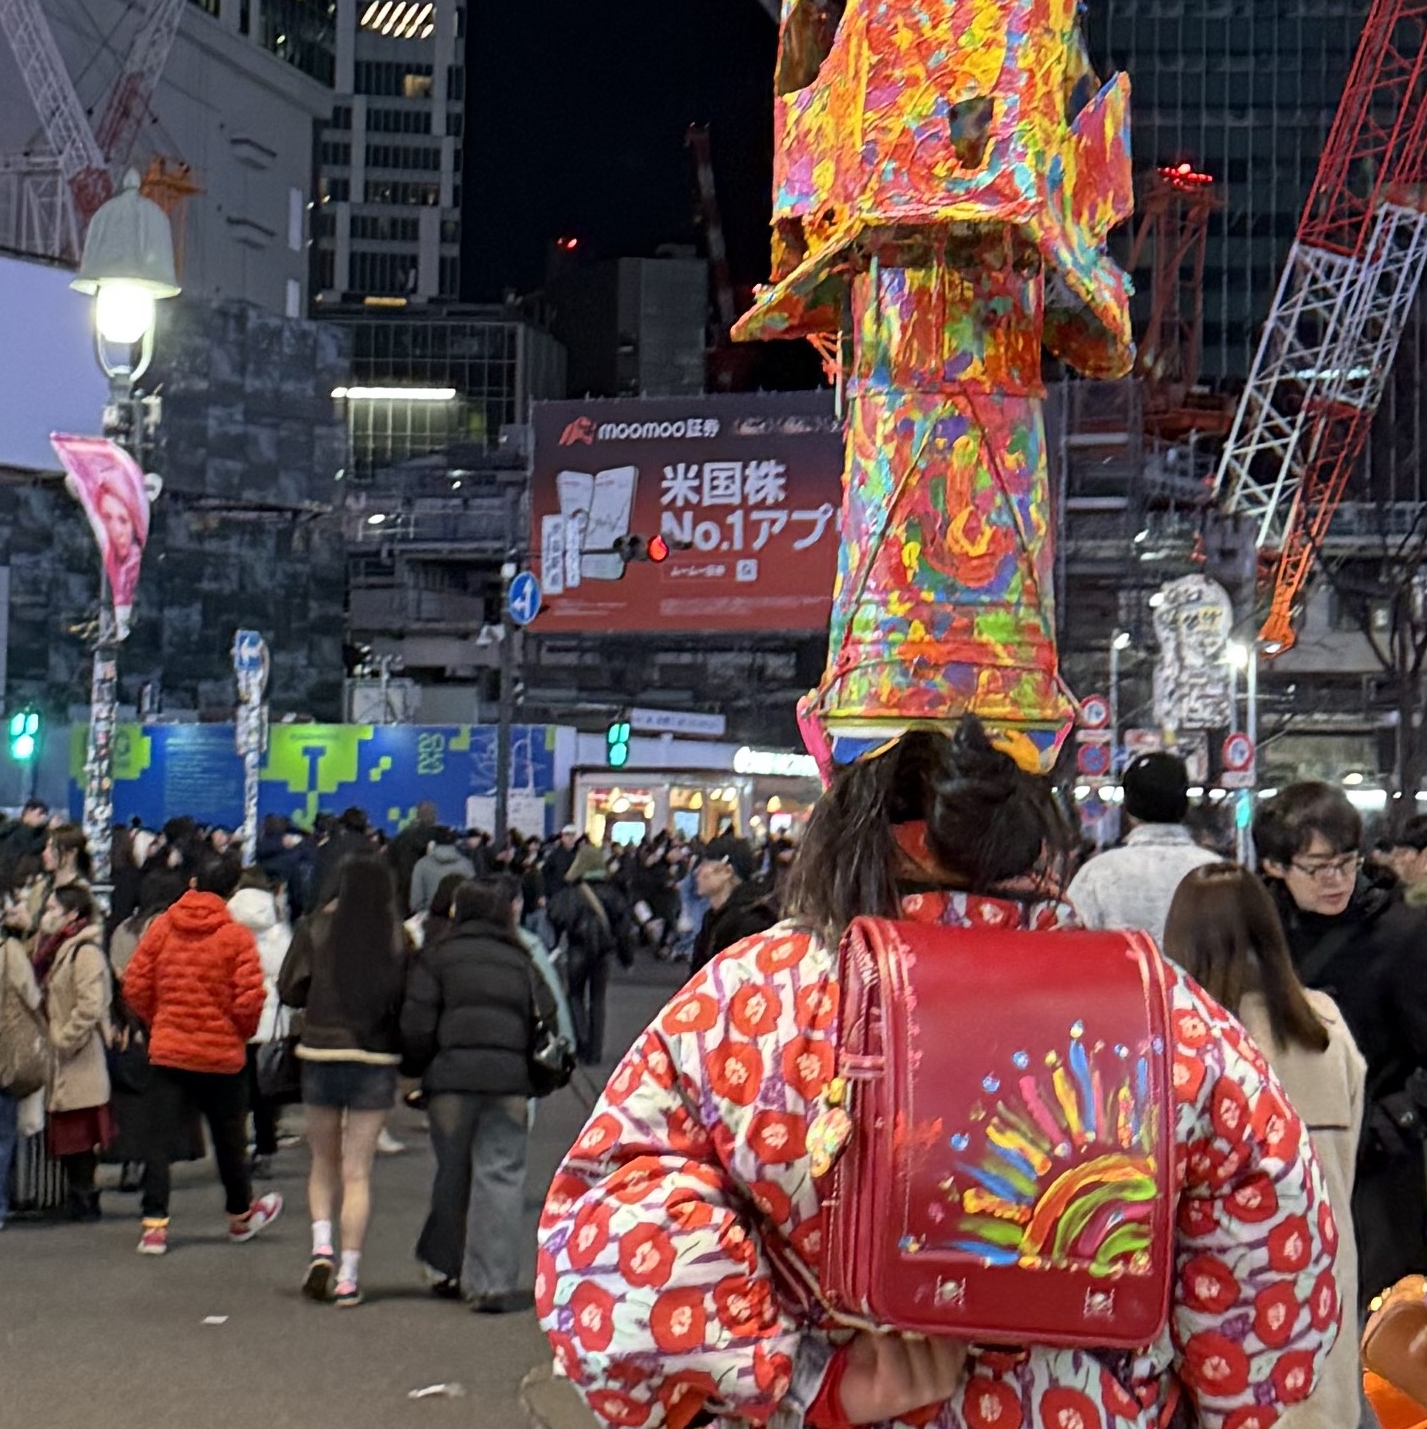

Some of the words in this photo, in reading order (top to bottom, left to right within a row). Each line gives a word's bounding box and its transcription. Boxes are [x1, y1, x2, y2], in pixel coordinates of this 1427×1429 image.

[598, 418, 720, 440] moomoo証券
[660, 458, 787, 507] 米国株
[661, 503, 842, 551] No.1アプ
